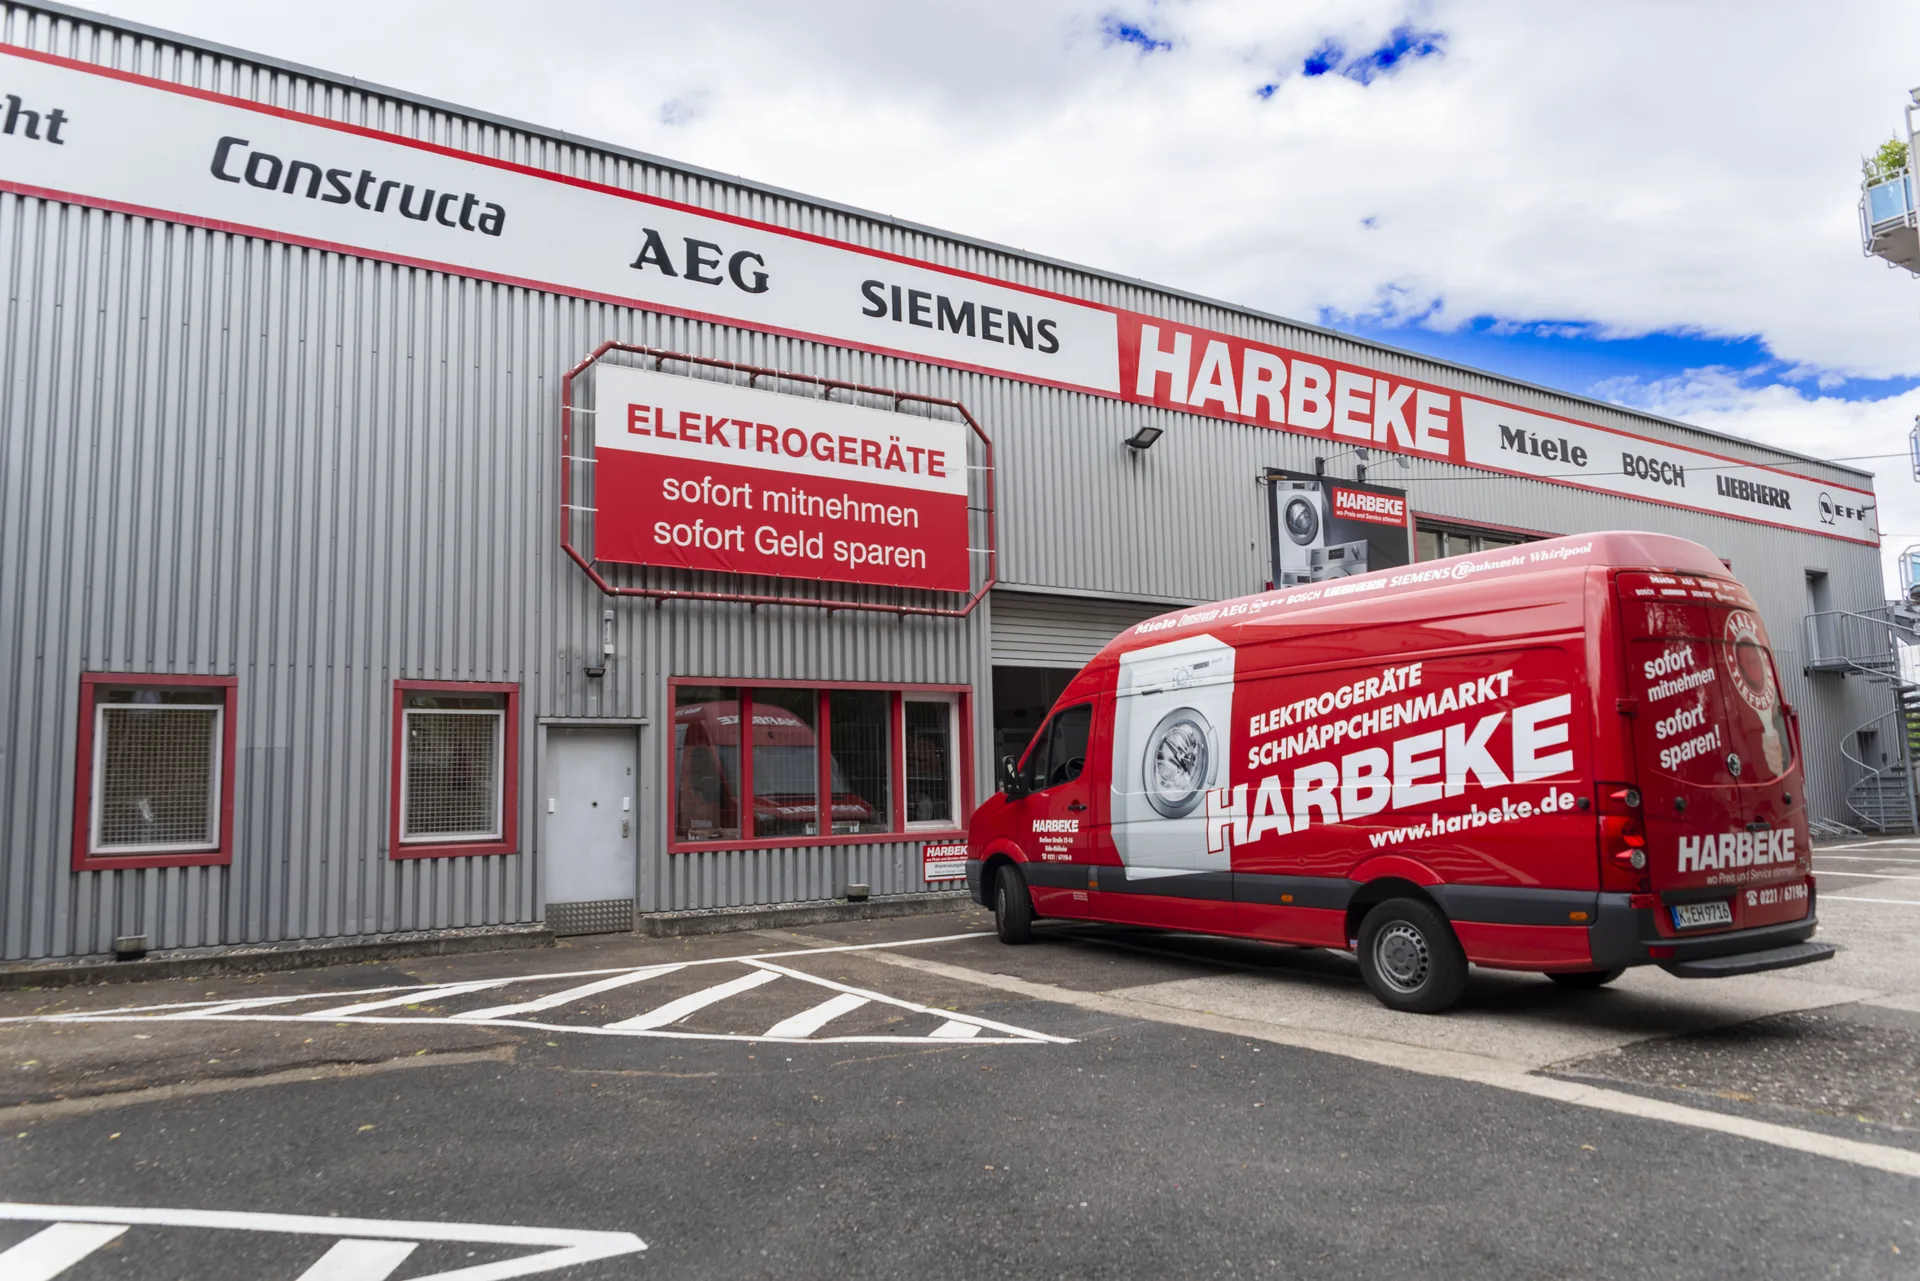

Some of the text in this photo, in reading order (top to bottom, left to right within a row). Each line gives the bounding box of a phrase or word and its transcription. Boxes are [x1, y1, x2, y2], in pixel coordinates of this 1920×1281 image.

[0, 93, 69, 145] ht
[210, 135, 506, 237] Constructa
[629, 227, 769, 294] AEG
[861, 279, 1060, 354] SIEMENS
[1136, 323, 1450, 456] HARBEKE
[627, 403, 946, 478] ELEKTROGERÄTE
[1499, 424, 1588, 467] Miele
[1622, 452, 1686, 488] BOSCH
[1716, 474, 1792, 511] LIEBHERR
[662, 476, 919, 528] sofort mitnehmen
[1336, 491, 1403, 516] HARBEKE
[1819, 495, 1866, 524] NEFF
[653, 518, 926, 569] sofort Geld sparen
[1134, 618, 1177, 635] Miele
[1218, 603, 1248, 619] AEG
[1286, 590, 1321, 605] BOSCH
[1389, 567, 1450, 588] SIEMENS
[1451, 555, 1526, 580] Bauknecht
[1530, 542, 1593, 563] Whirlpool
[1728, 613, 1758, 637] HALT
[1644, 645, 1695, 680] sofort
[1648, 667, 1716, 702] mitnehmen
[1248, 669, 1513, 770] SCHNÄPPCHENMARKT
[1249, 661, 1422, 738] ELEKTROGERÄTE
[1655, 703, 1706, 740] sofort
[1660, 724, 1722, 772] sparen!
[1206, 693, 1575, 855] HARBEKE
[1032, 819, 1079, 833] HARBEKE
[1369, 786, 1575, 849] www.harbeke.de
[926, 845, 968, 857] HARBEK
[1678, 828, 1795, 873] HARBEKE
[1706, 875, 1718, 885] wo
[1719, 872, 1736, 884] Preis
[1751, 867, 1772, 880] Service
[1760, 888, 1778, 905] 0221
